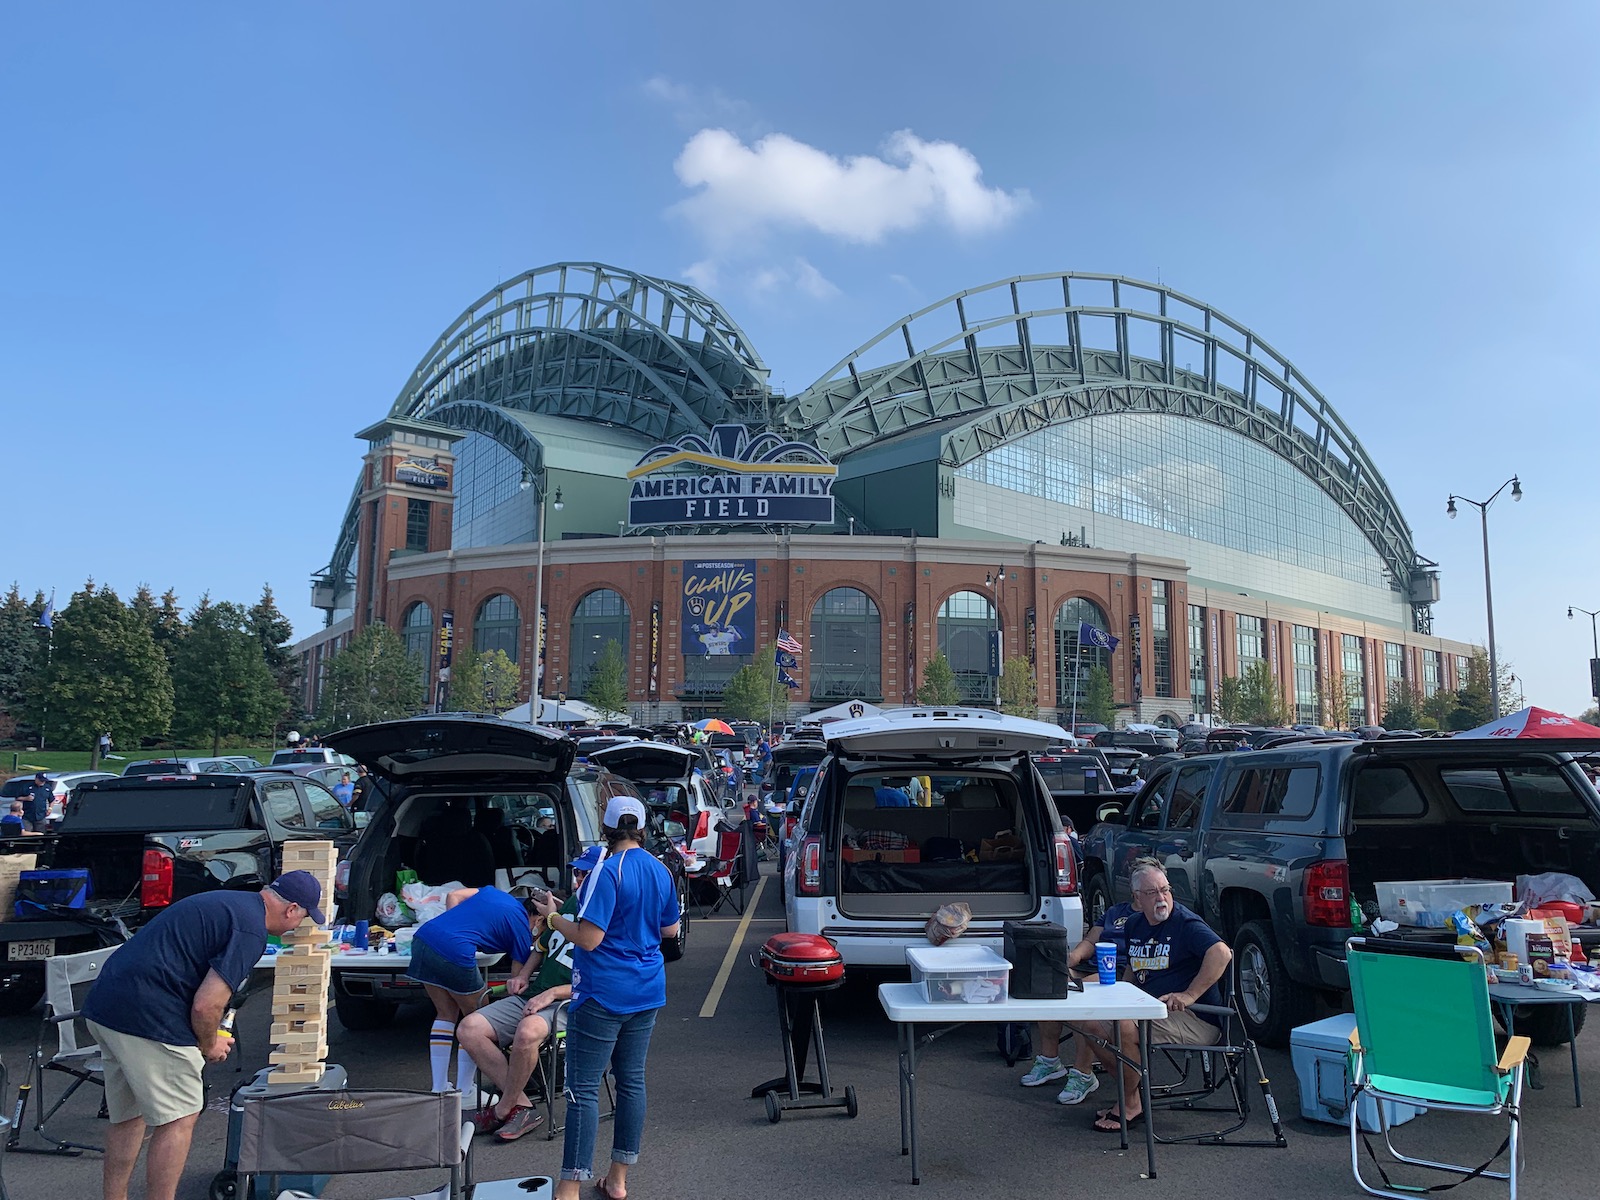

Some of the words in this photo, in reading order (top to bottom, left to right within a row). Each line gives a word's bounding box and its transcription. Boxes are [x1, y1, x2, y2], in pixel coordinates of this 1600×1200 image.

[630, 477, 741, 499] AMERICAN
[751, 477, 832, 495] FAMILY
[686, 499, 769, 517] FIELD
[685, 568, 754, 596] CLAWS
[704, 593, 753, 628] UP
[440, 627, 449, 655] CAIN
[1541, 716, 1574, 725] ACE
[1488, 727, 1518, 737] ACE
[18, 943, 51, 957] PZ3406
[1128, 944, 1152, 957] BUILT
